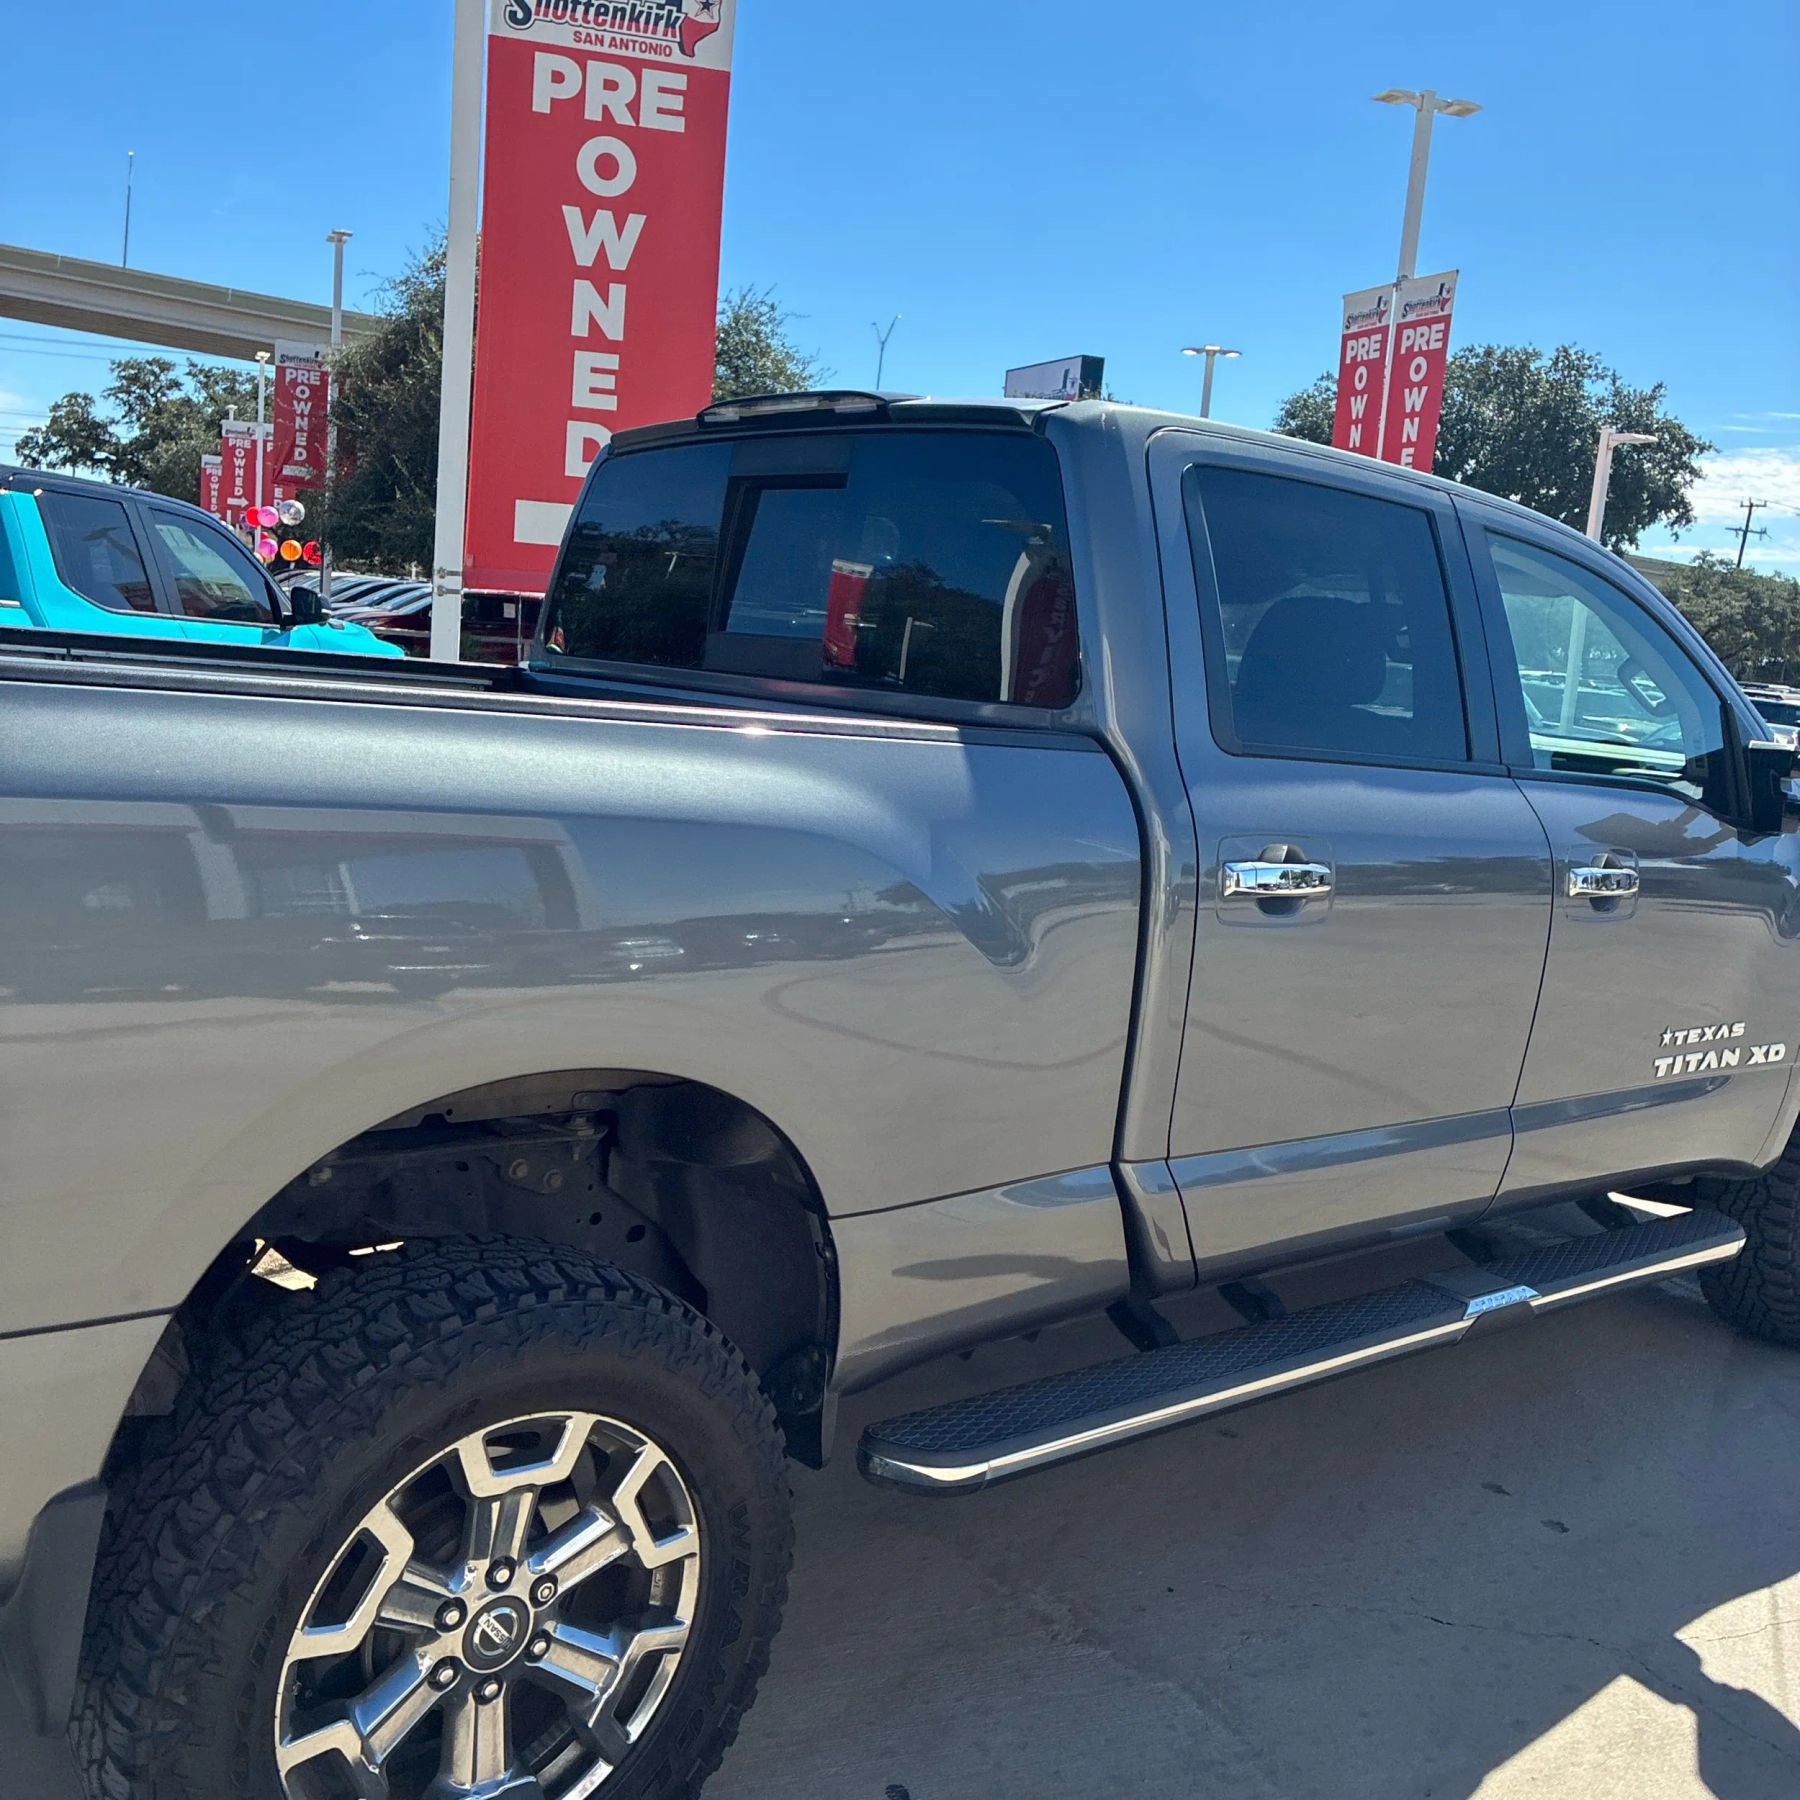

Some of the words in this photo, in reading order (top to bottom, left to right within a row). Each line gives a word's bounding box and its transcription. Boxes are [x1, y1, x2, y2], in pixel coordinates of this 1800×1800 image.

[573, 30, 604, 47] SAN
[608, 36, 673, 58] ANTONIO
[532, 51, 688, 133] PRE
[562, 136, 647, 478] OWNED
[1345, 333, 1382, 364] PRE
[1400, 322, 1445, 355] PRE
[285, 368, 321, 385] PRE
[293, 385, 312, 460] OWNED
[1349, 366, 1368, 449] OWN
[1401, 356, 1428, 468] OWNE
[229, 438, 251, 448] PRE
[233, 448, 246, 496] OWNED
[1674, 1021, 1746, 1046] TEXAS
[1654, 1047, 1741, 1078] TITAN
[1746, 1043, 1786, 1065] XD
